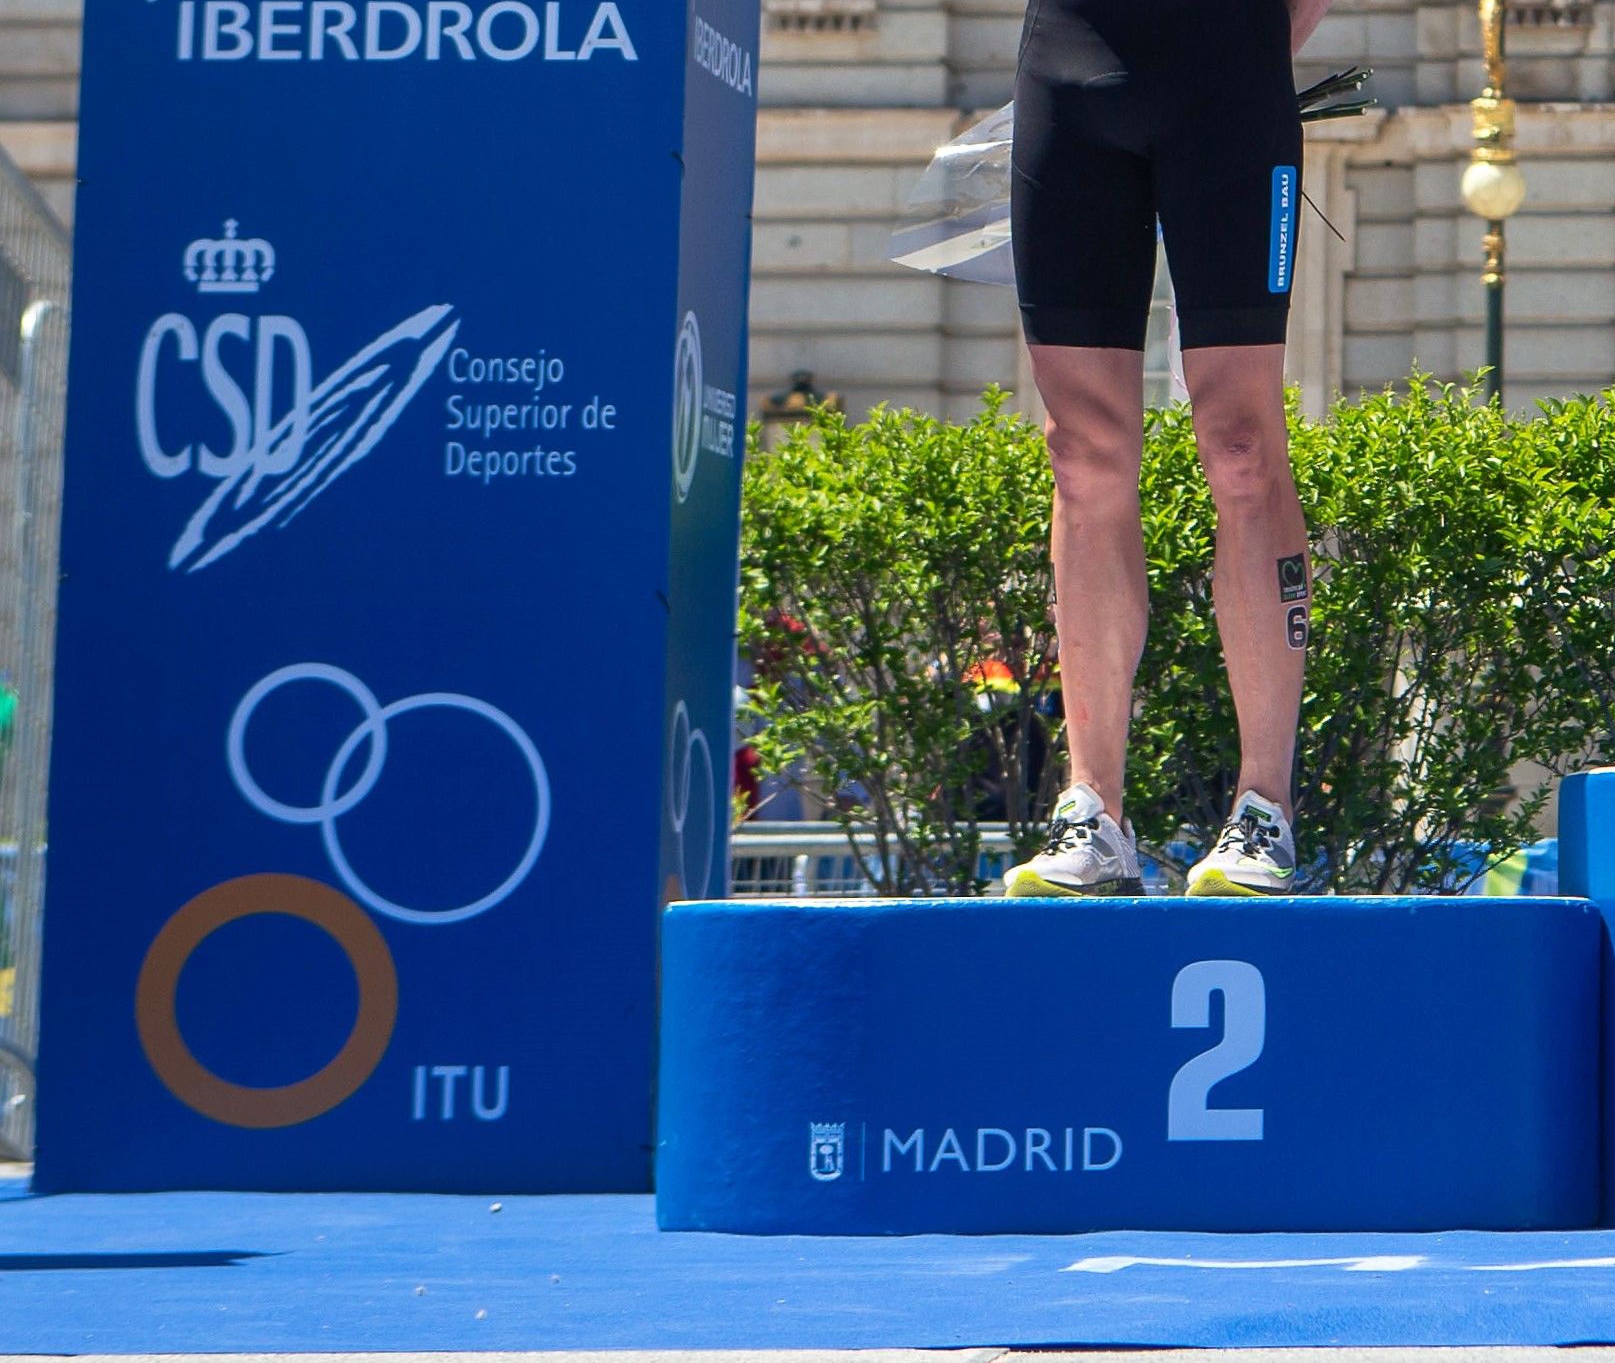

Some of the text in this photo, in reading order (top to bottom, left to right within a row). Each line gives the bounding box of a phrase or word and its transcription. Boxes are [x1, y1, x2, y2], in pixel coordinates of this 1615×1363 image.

[177, 0, 639, 62] IBERDROLA
[695, 14, 753, 98] IBERDROLA
[1277, 173, 1289, 288] BRUNZEL BAU
[135, 312, 313, 479] CSD
[448, 347, 565, 392] Consejo
[445, 394, 617, 439] Superior de
[444, 441, 577, 485] Deportes
[1286, 604, 1309, 650] 6
[1166, 959, 1267, 1142] 2
[411, 1064, 510, 1120] ITU
[881, 1126, 1123, 1173] MADRID
